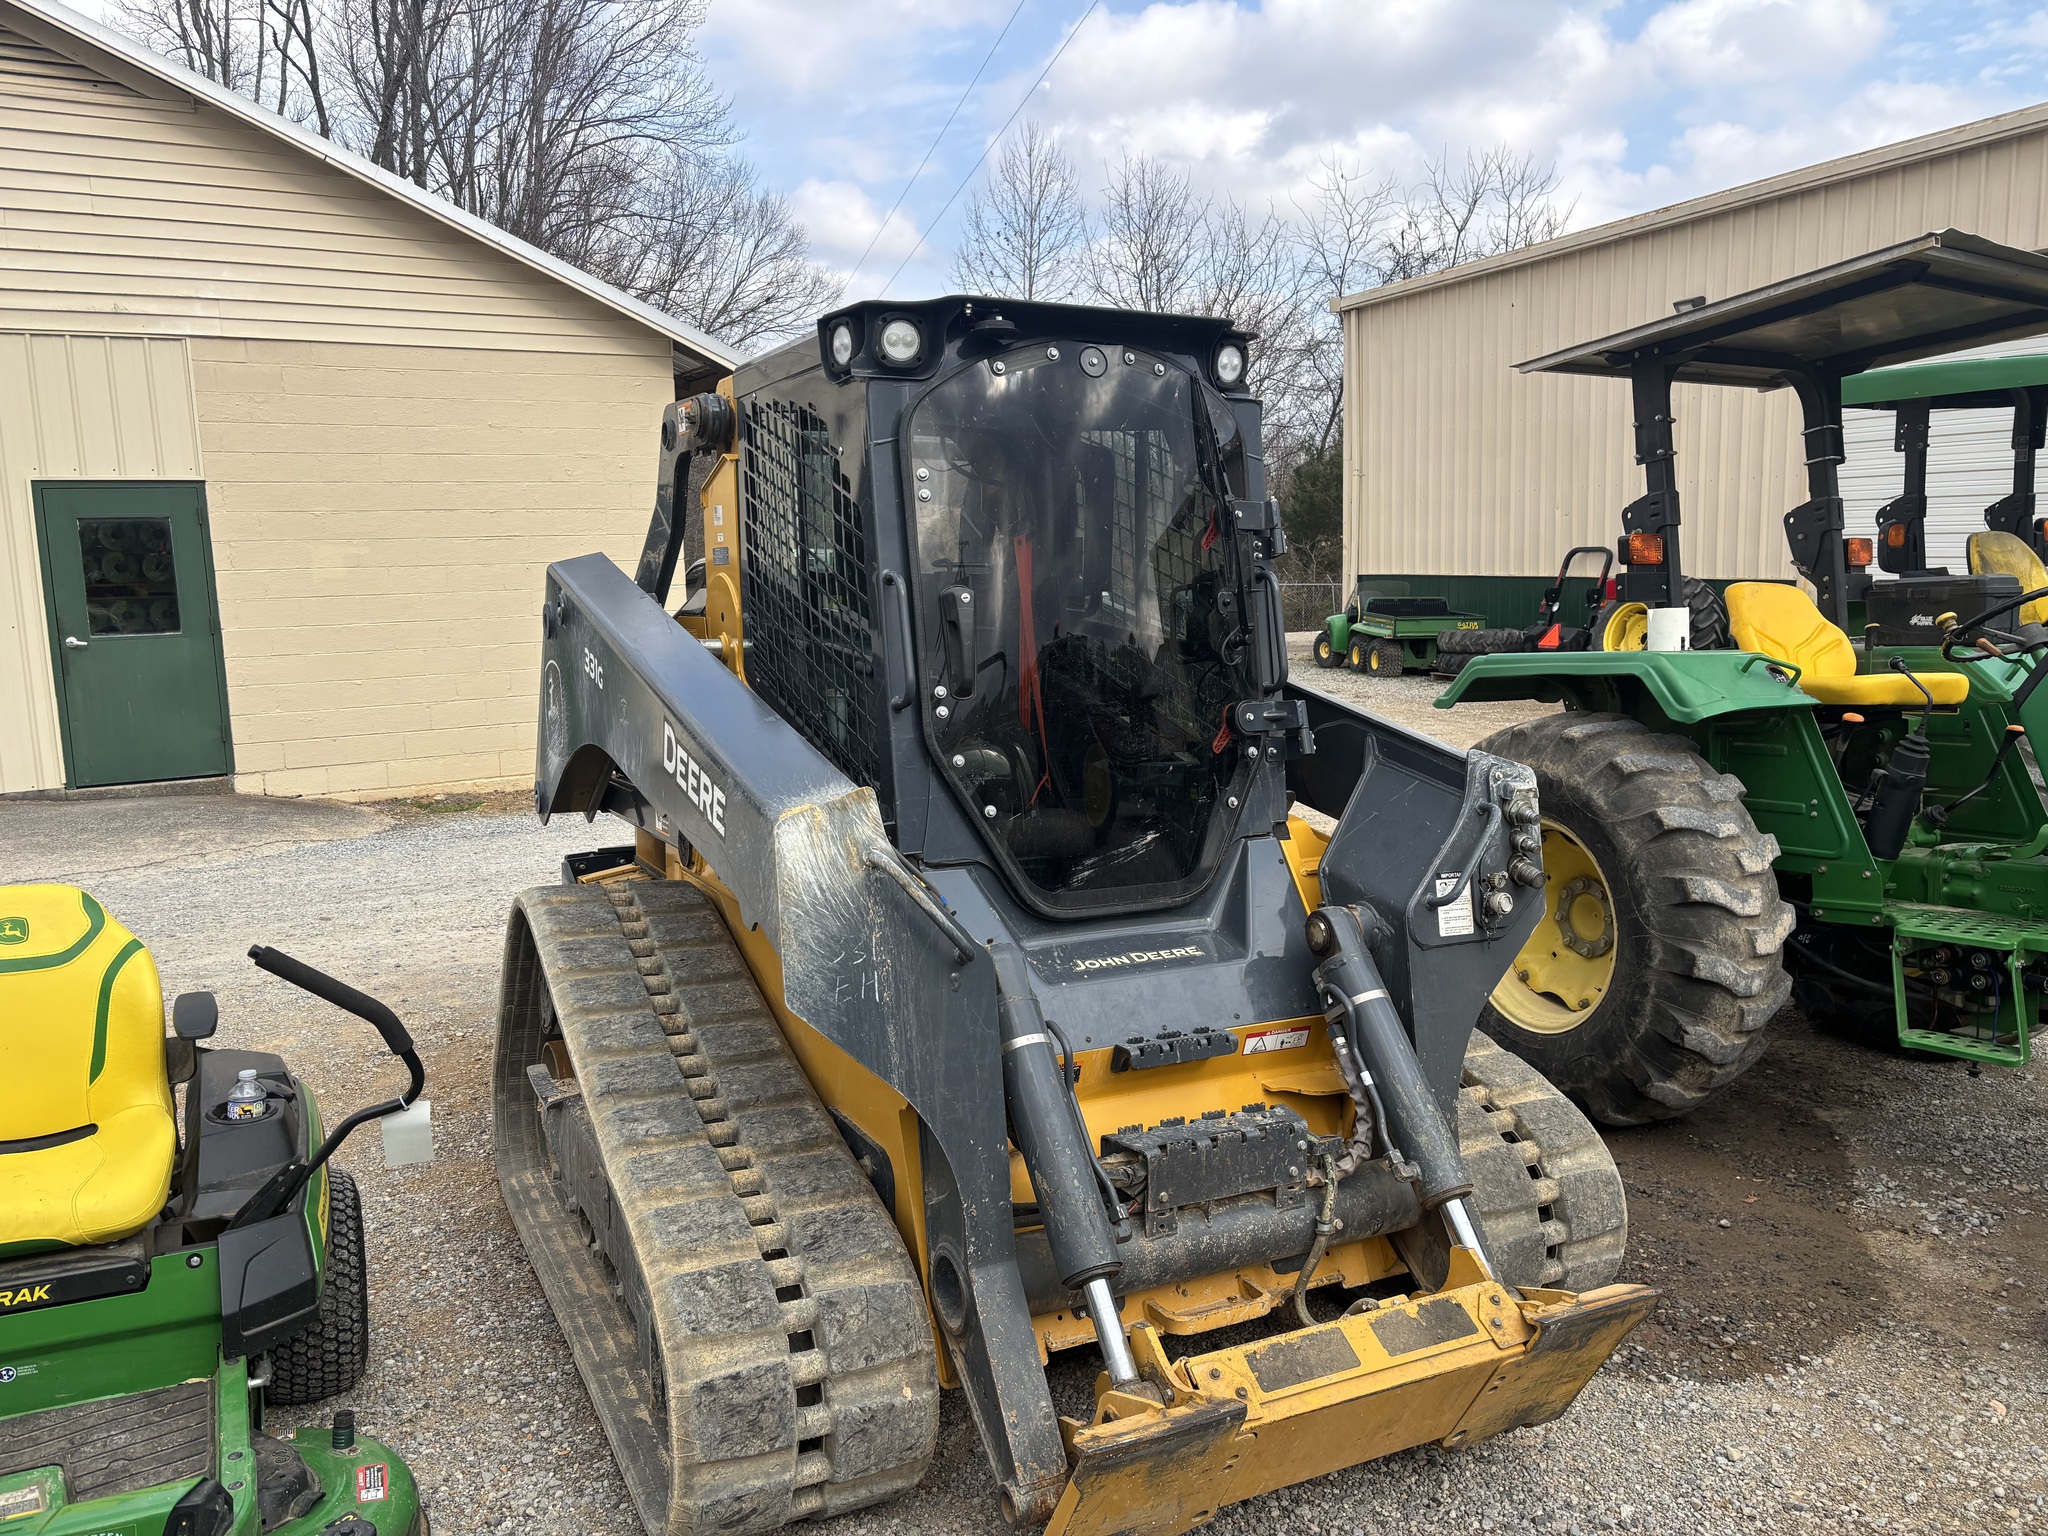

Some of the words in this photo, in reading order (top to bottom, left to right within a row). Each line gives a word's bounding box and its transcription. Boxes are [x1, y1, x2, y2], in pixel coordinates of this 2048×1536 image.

[584, 647, 604, 690] 331G
[663, 721, 726, 838] DEERE
[1074, 955, 1131, 971] JOHN
[1130, 946, 1205, 963] DEERE
[0, 1284, 52, 1306] RAK
